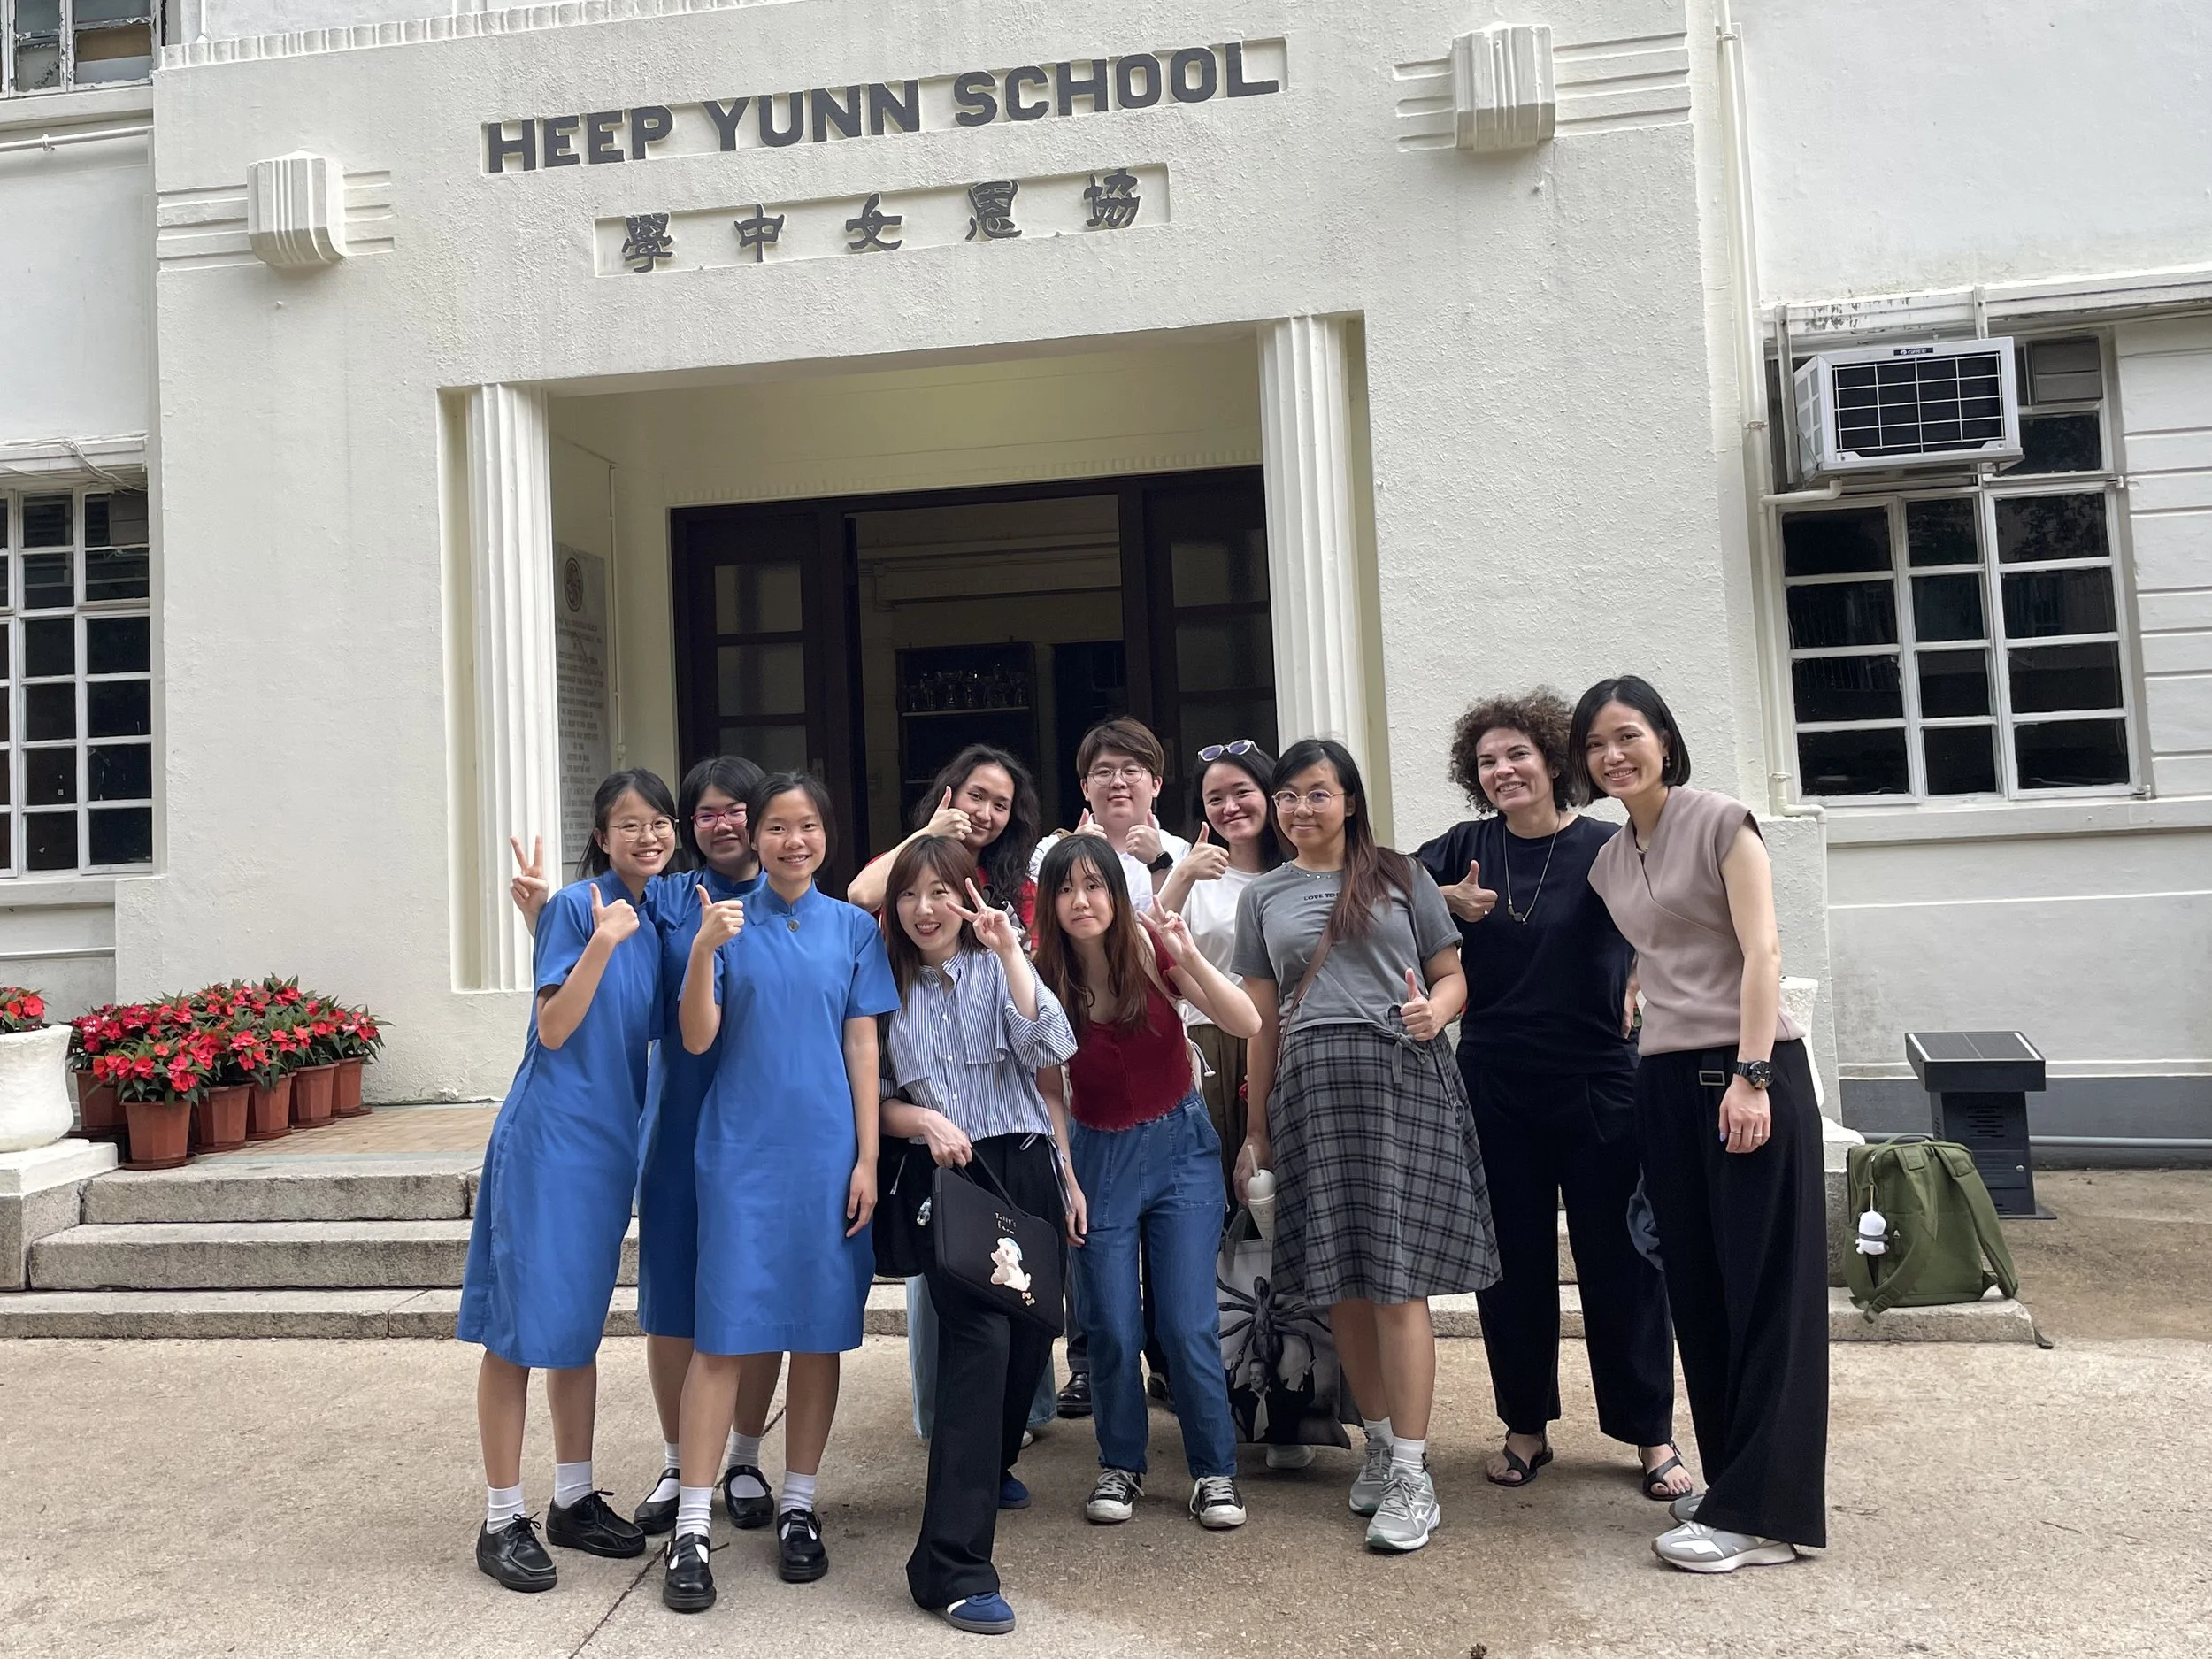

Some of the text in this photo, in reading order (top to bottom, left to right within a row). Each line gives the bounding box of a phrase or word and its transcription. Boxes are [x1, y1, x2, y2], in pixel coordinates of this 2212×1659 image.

[488, 42, 1279, 173] HEEP YUNN SCHOOL
